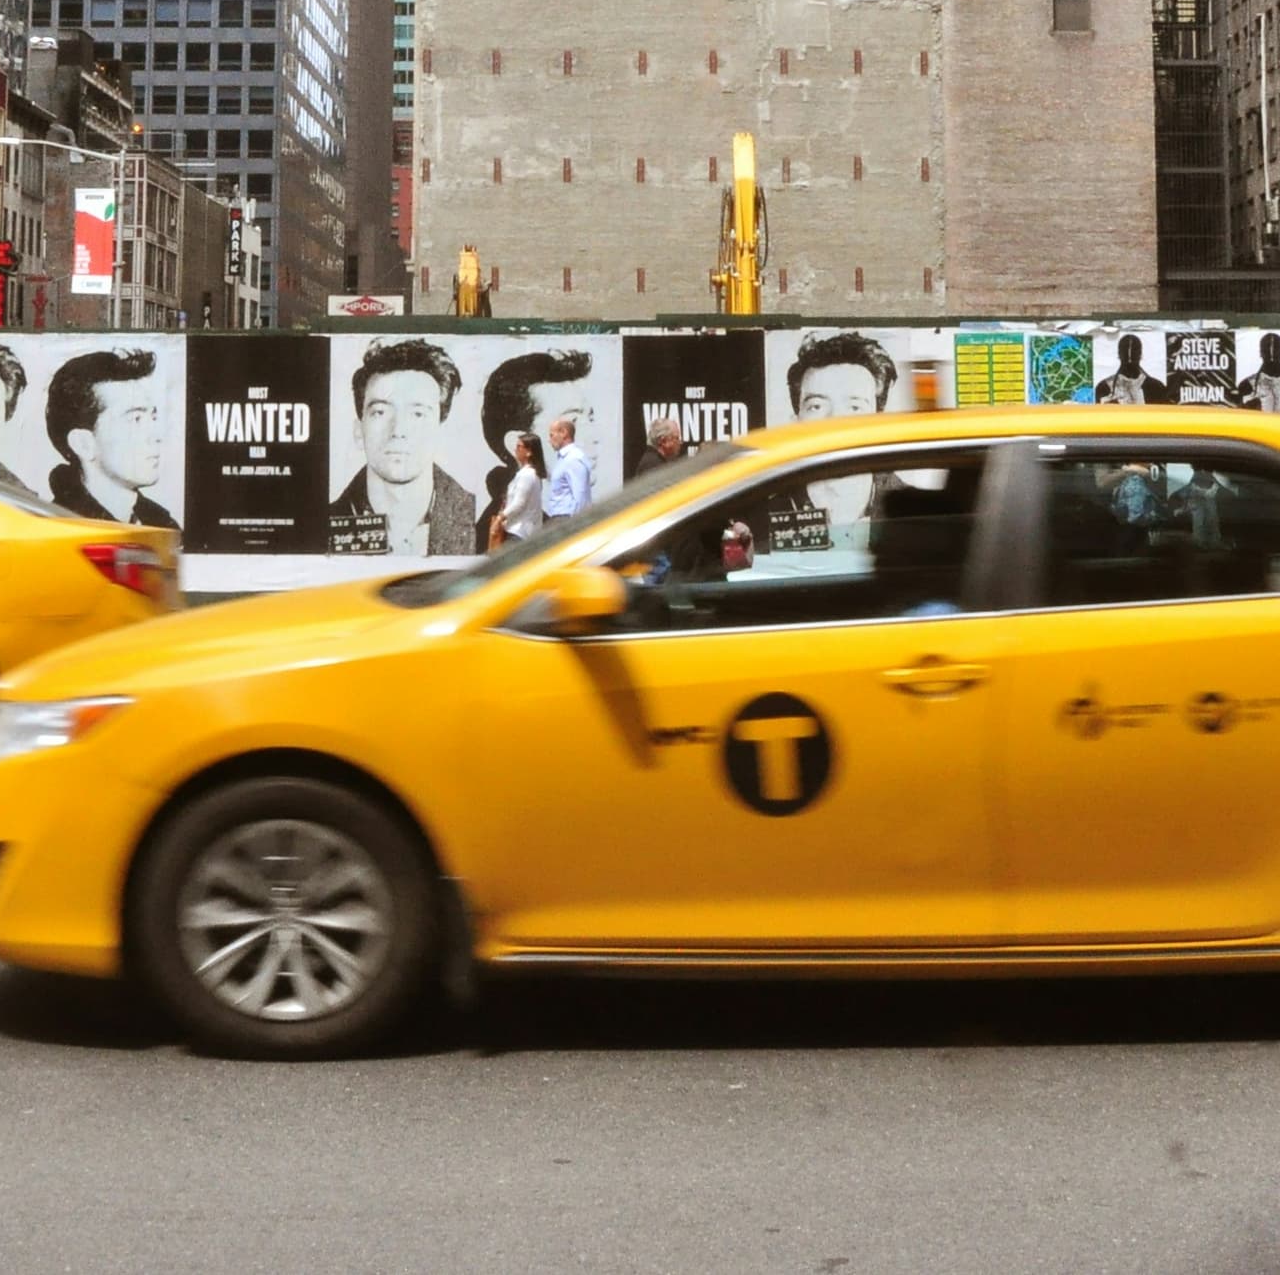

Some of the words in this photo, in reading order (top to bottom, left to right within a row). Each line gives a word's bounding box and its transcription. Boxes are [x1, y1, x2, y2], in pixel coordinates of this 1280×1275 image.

[231, 220, 241, 263] PARK
[203, 305, 211, 329] PA
[1182, 338, 1221, 354] STEVE
[1174, 354, 1229, 371] ANGELLO
[248, 386, 269, 399] MOST
[685, 386, 706, 399] MOST
[1180, 386, 1225, 403] HUMAN
[205, 402, 311, 443] WANTED
[734, 716, 818, 801] T
